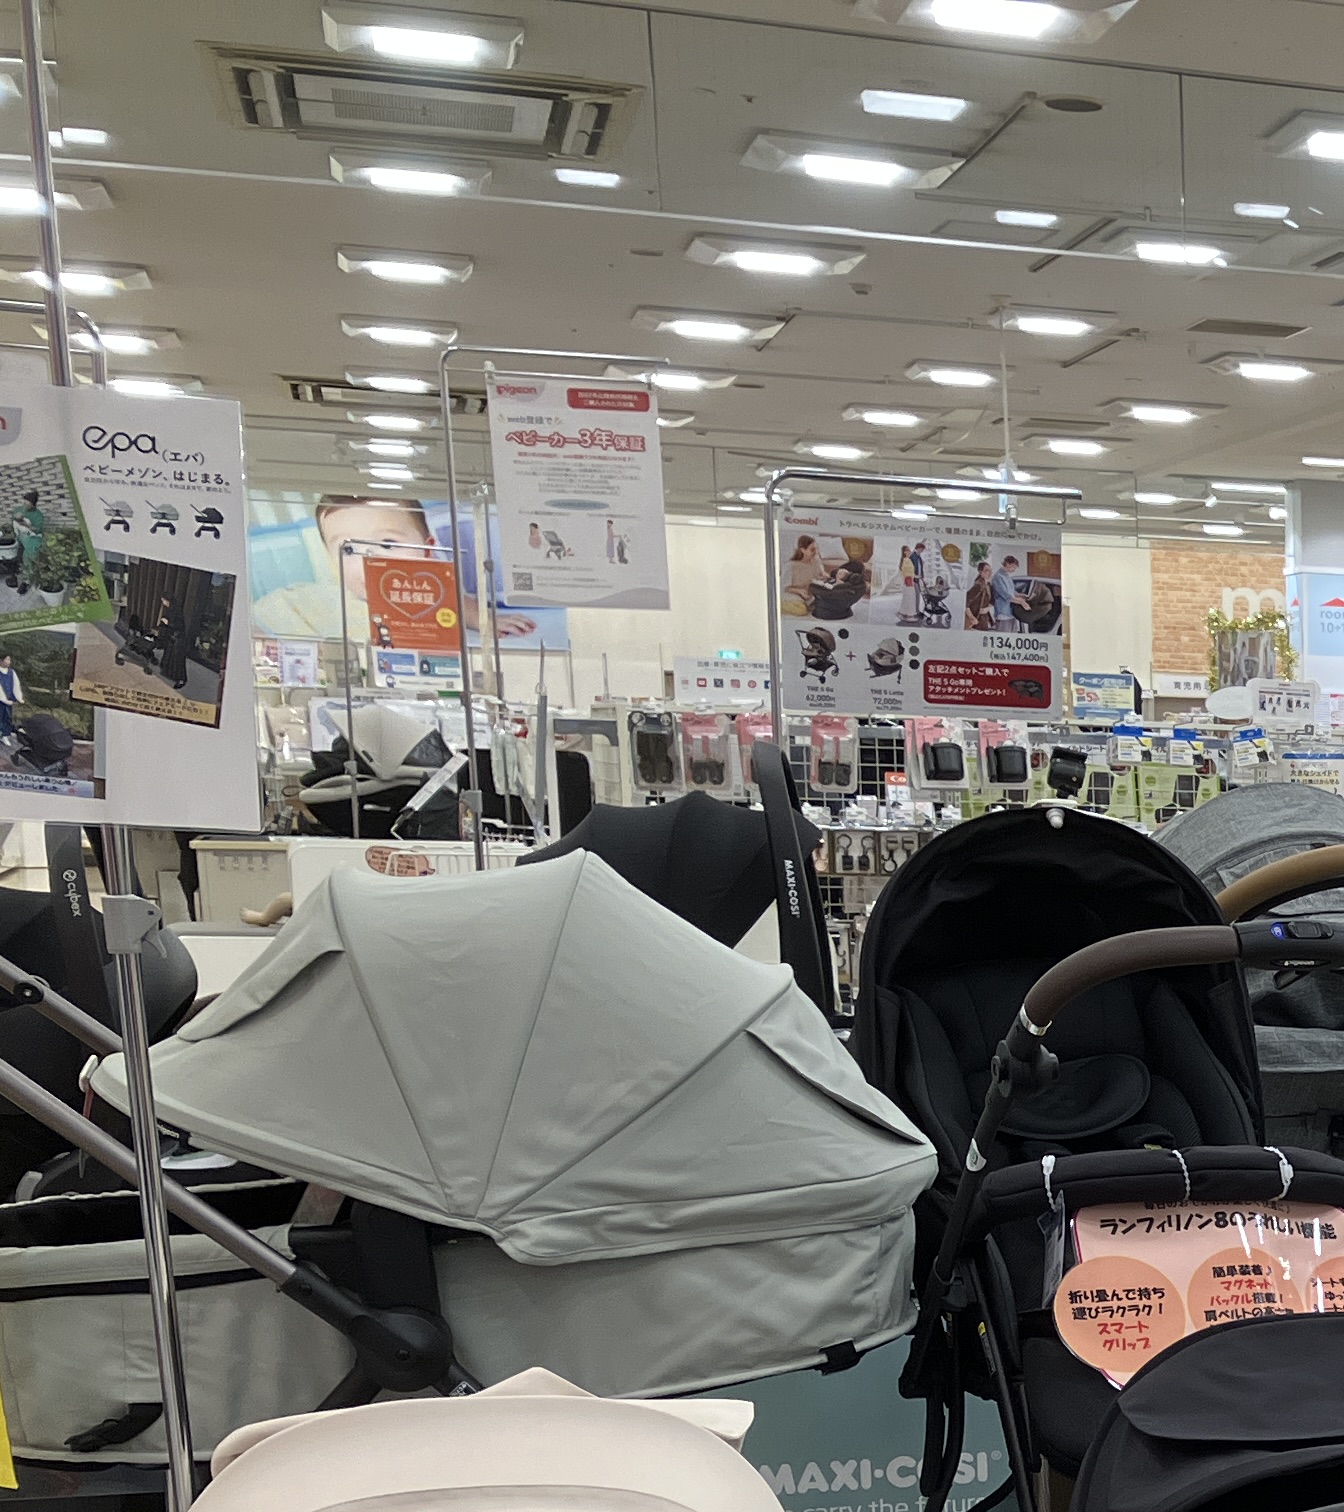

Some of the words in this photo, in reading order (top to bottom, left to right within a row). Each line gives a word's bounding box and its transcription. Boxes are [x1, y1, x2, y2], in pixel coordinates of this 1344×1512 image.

[82, 426, 158, 458] epa
[505, 428, 646, 452] ベビーカー3年保証
[83, 463, 231, 487] ベビーメゾン、はじまる。
[391, 578, 431, 591] あんしん
[1220, 1279, 1272, 1291] マグネット
[1068, 1287, 1166, 1304] 折り畳んで持ち
[1072, 1303, 1163, 1320] 運びラクラク!
[1098, 1320, 1150, 1335] スマート
[1102, 1336, 1152, 1351] グリップ
